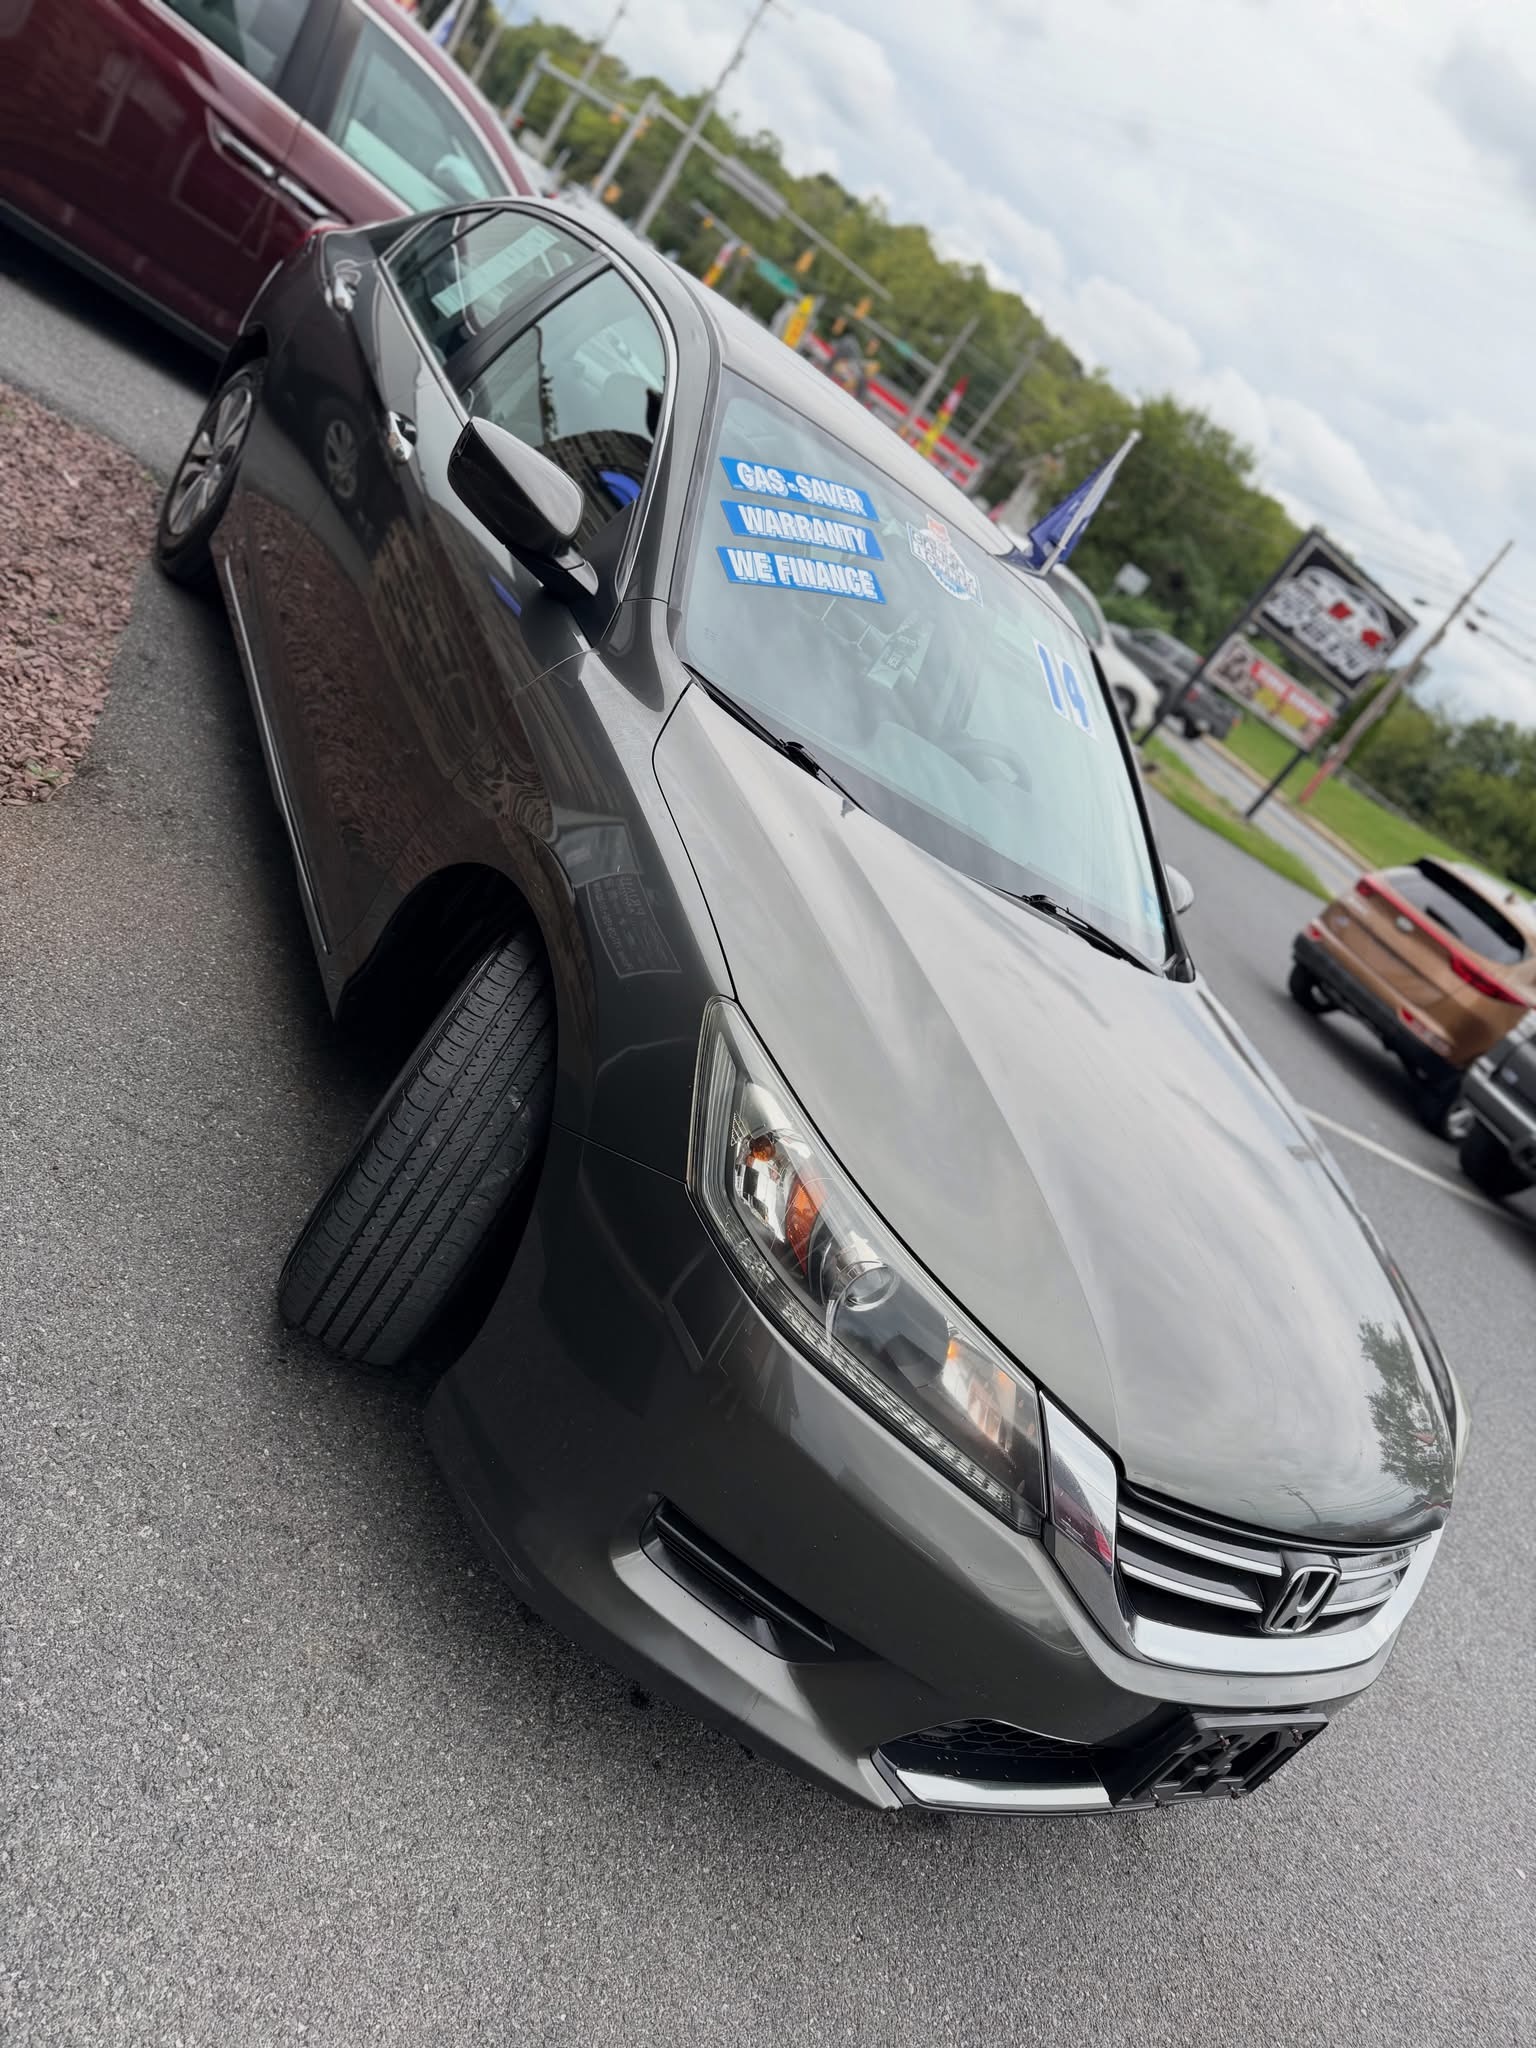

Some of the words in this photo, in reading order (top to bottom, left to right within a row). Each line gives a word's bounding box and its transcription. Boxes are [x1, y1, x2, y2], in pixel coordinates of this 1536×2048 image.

[736, 462, 868, 517] GAS-SAVER
[738, 505, 869, 555] WARRANTY
[727, 549, 776, 583] WE
[775, 555, 878, 600] FINANCE
[1036, 641, 1091, 731] 14
